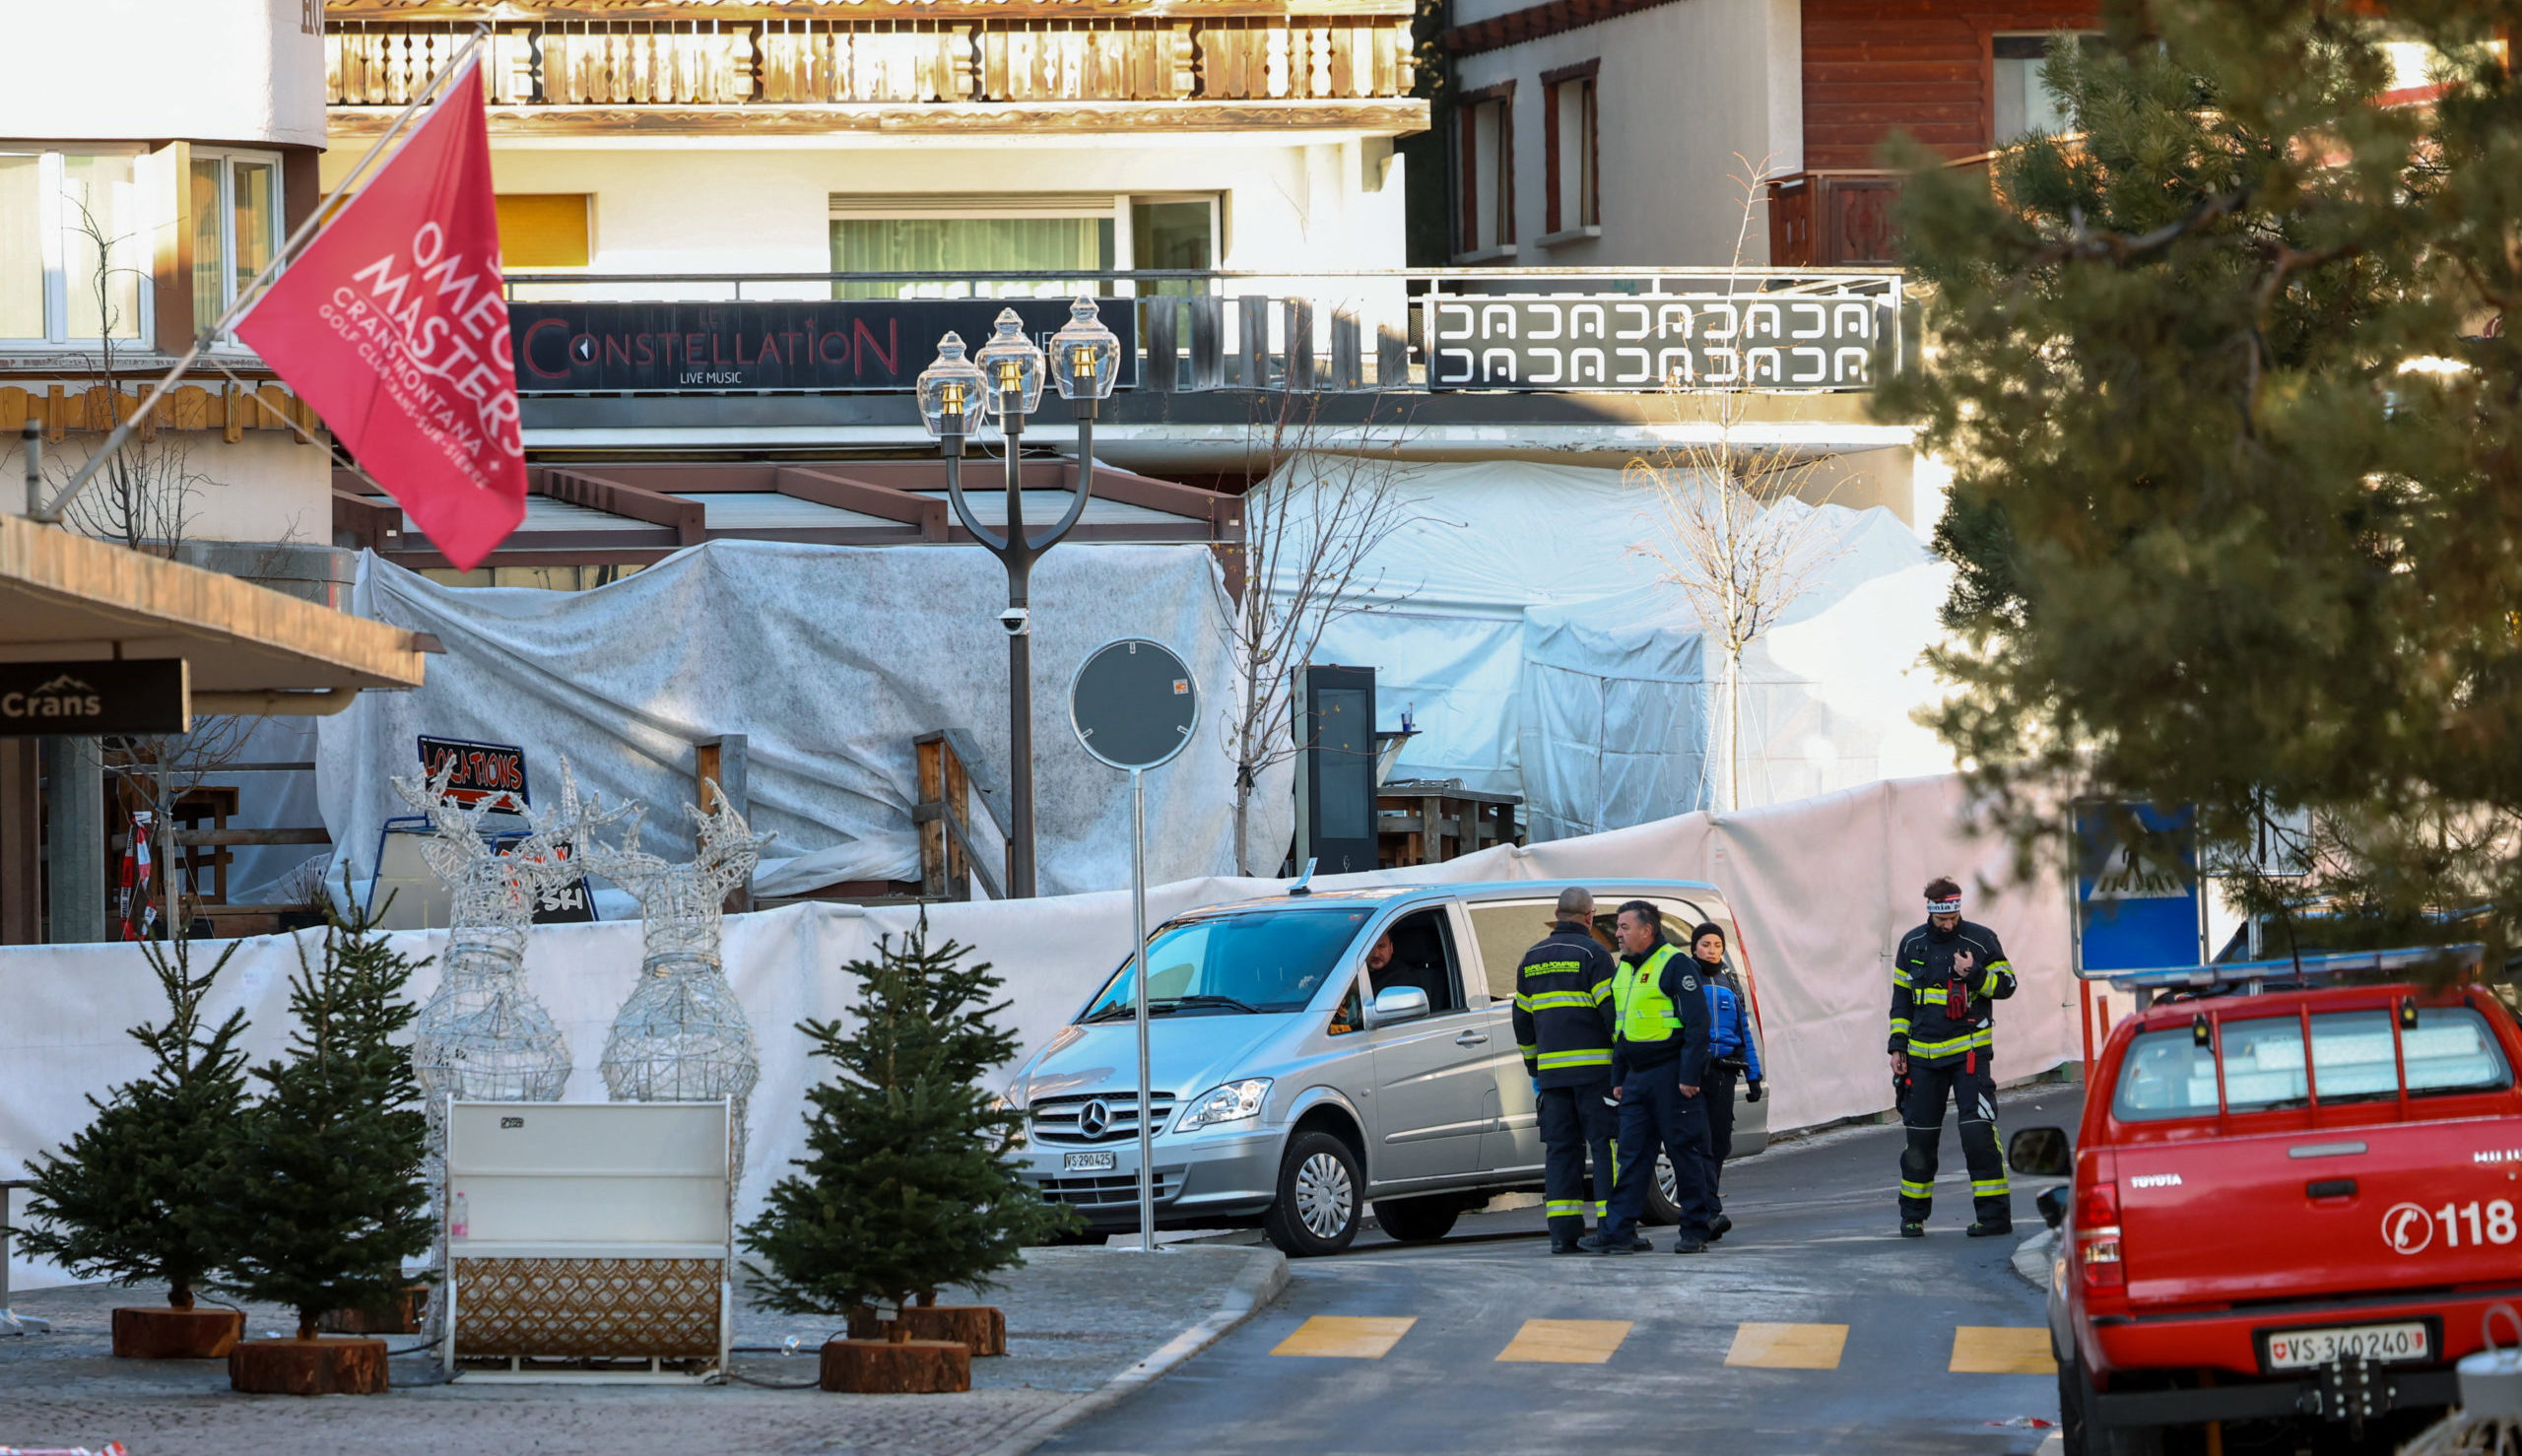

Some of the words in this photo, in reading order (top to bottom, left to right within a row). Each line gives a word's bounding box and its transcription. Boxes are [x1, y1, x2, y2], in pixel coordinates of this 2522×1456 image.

[318, 303, 359, 343] GOLF
[332, 286, 402, 362] CRANS
[394, 355, 483, 458] MONTANA
[680, 372, 704, 385] LIVE
[706, 371, 742, 385] MUSIC
[1, 693, 102, 718] Crans
[2130, 1173, 2183, 1189] TOYOTA
[2435, 1199, 2517, 1248] 118
